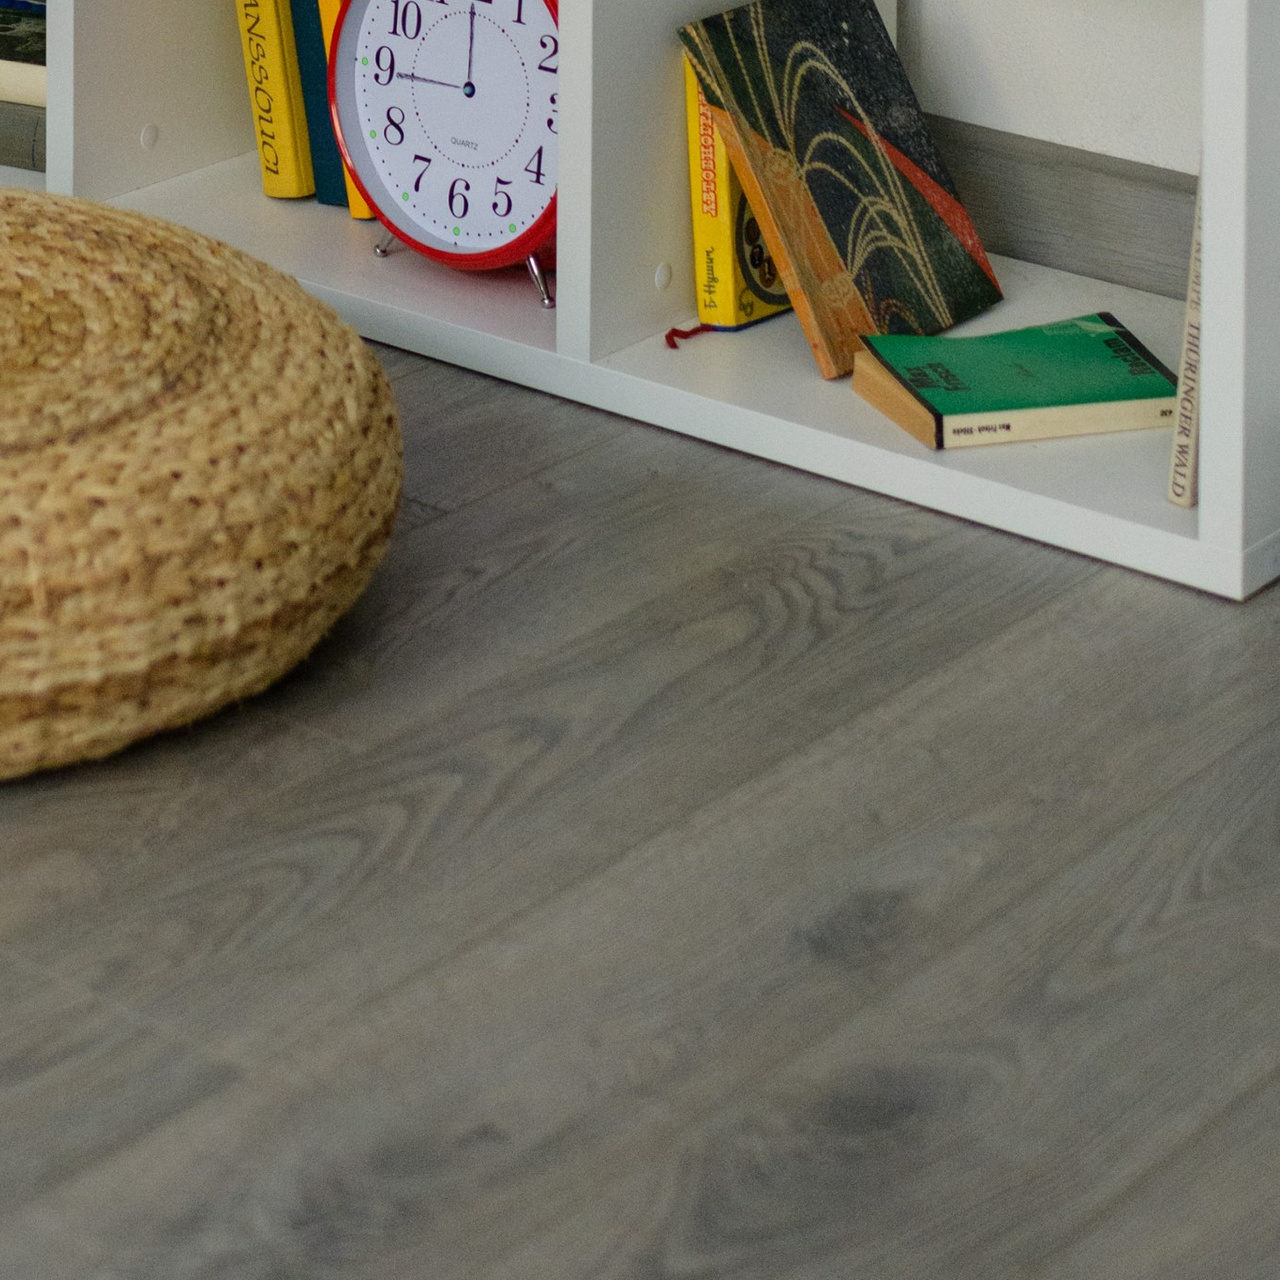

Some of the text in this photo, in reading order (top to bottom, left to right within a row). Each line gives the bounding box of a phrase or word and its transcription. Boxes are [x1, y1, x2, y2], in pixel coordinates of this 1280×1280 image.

[373, 45, 395, 86] 9
[537, 34, 559, 75] 2
[383, 106, 405, 146] 8
[450, 136, 479, 151] QUARTZ
[524, 145, 546, 186] 4
[697, 85, 718, 218] АВТОБИОГРА
[412, 154, 432, 193] 7
[448, 177, 471, 219] 6
[491, 176, 513, 218] 5
[1171, 442, 1189, 498] WALD
